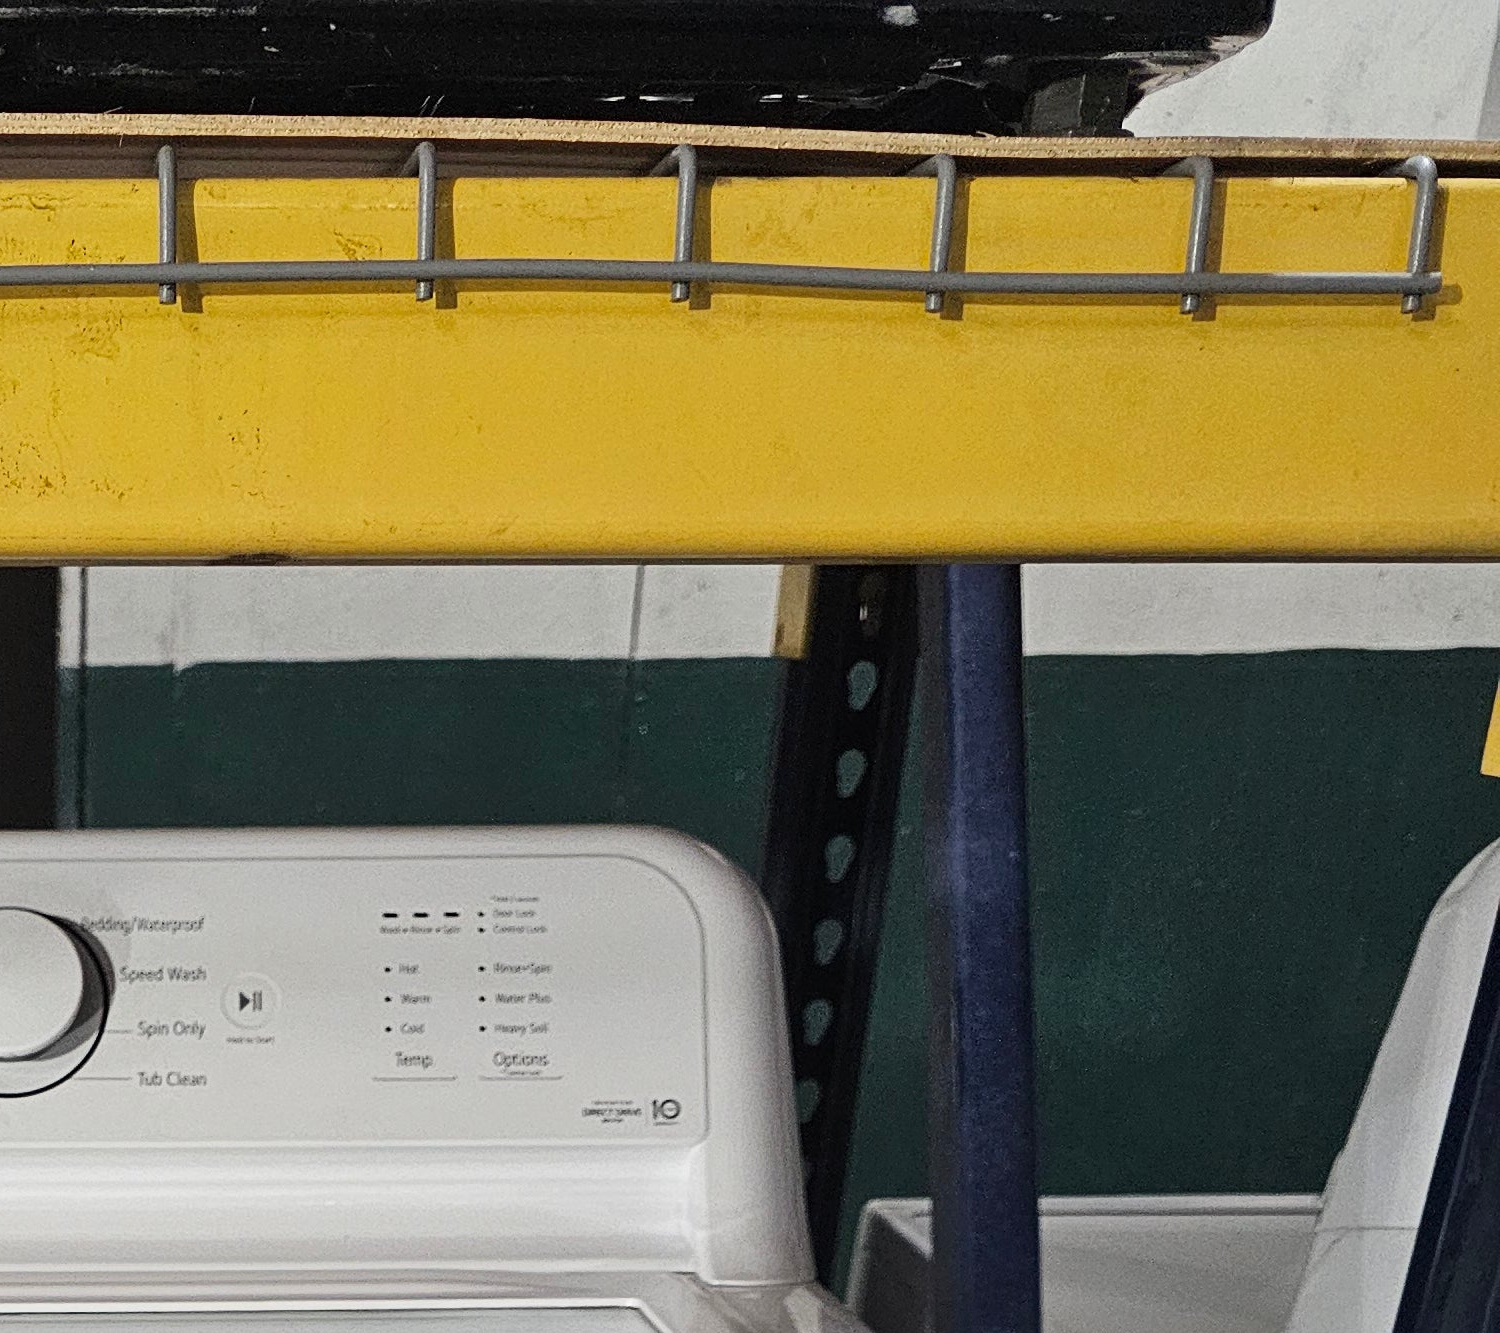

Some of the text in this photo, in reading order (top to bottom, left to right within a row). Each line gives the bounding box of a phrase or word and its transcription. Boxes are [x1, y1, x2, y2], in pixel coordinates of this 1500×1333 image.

[78, 915, 205, 936] Bedding/Waterproof
[118, 965, 207, 984] Speed Wash
[137, 1020, 206, 1039] Spin Only
[400, 1022, 425, 1034] Cold
[395, 1051, 434, 1069] Temp
[493, 1050, 550, 1068] Options
[137, 1071, 207, 1087] Tub Clean
